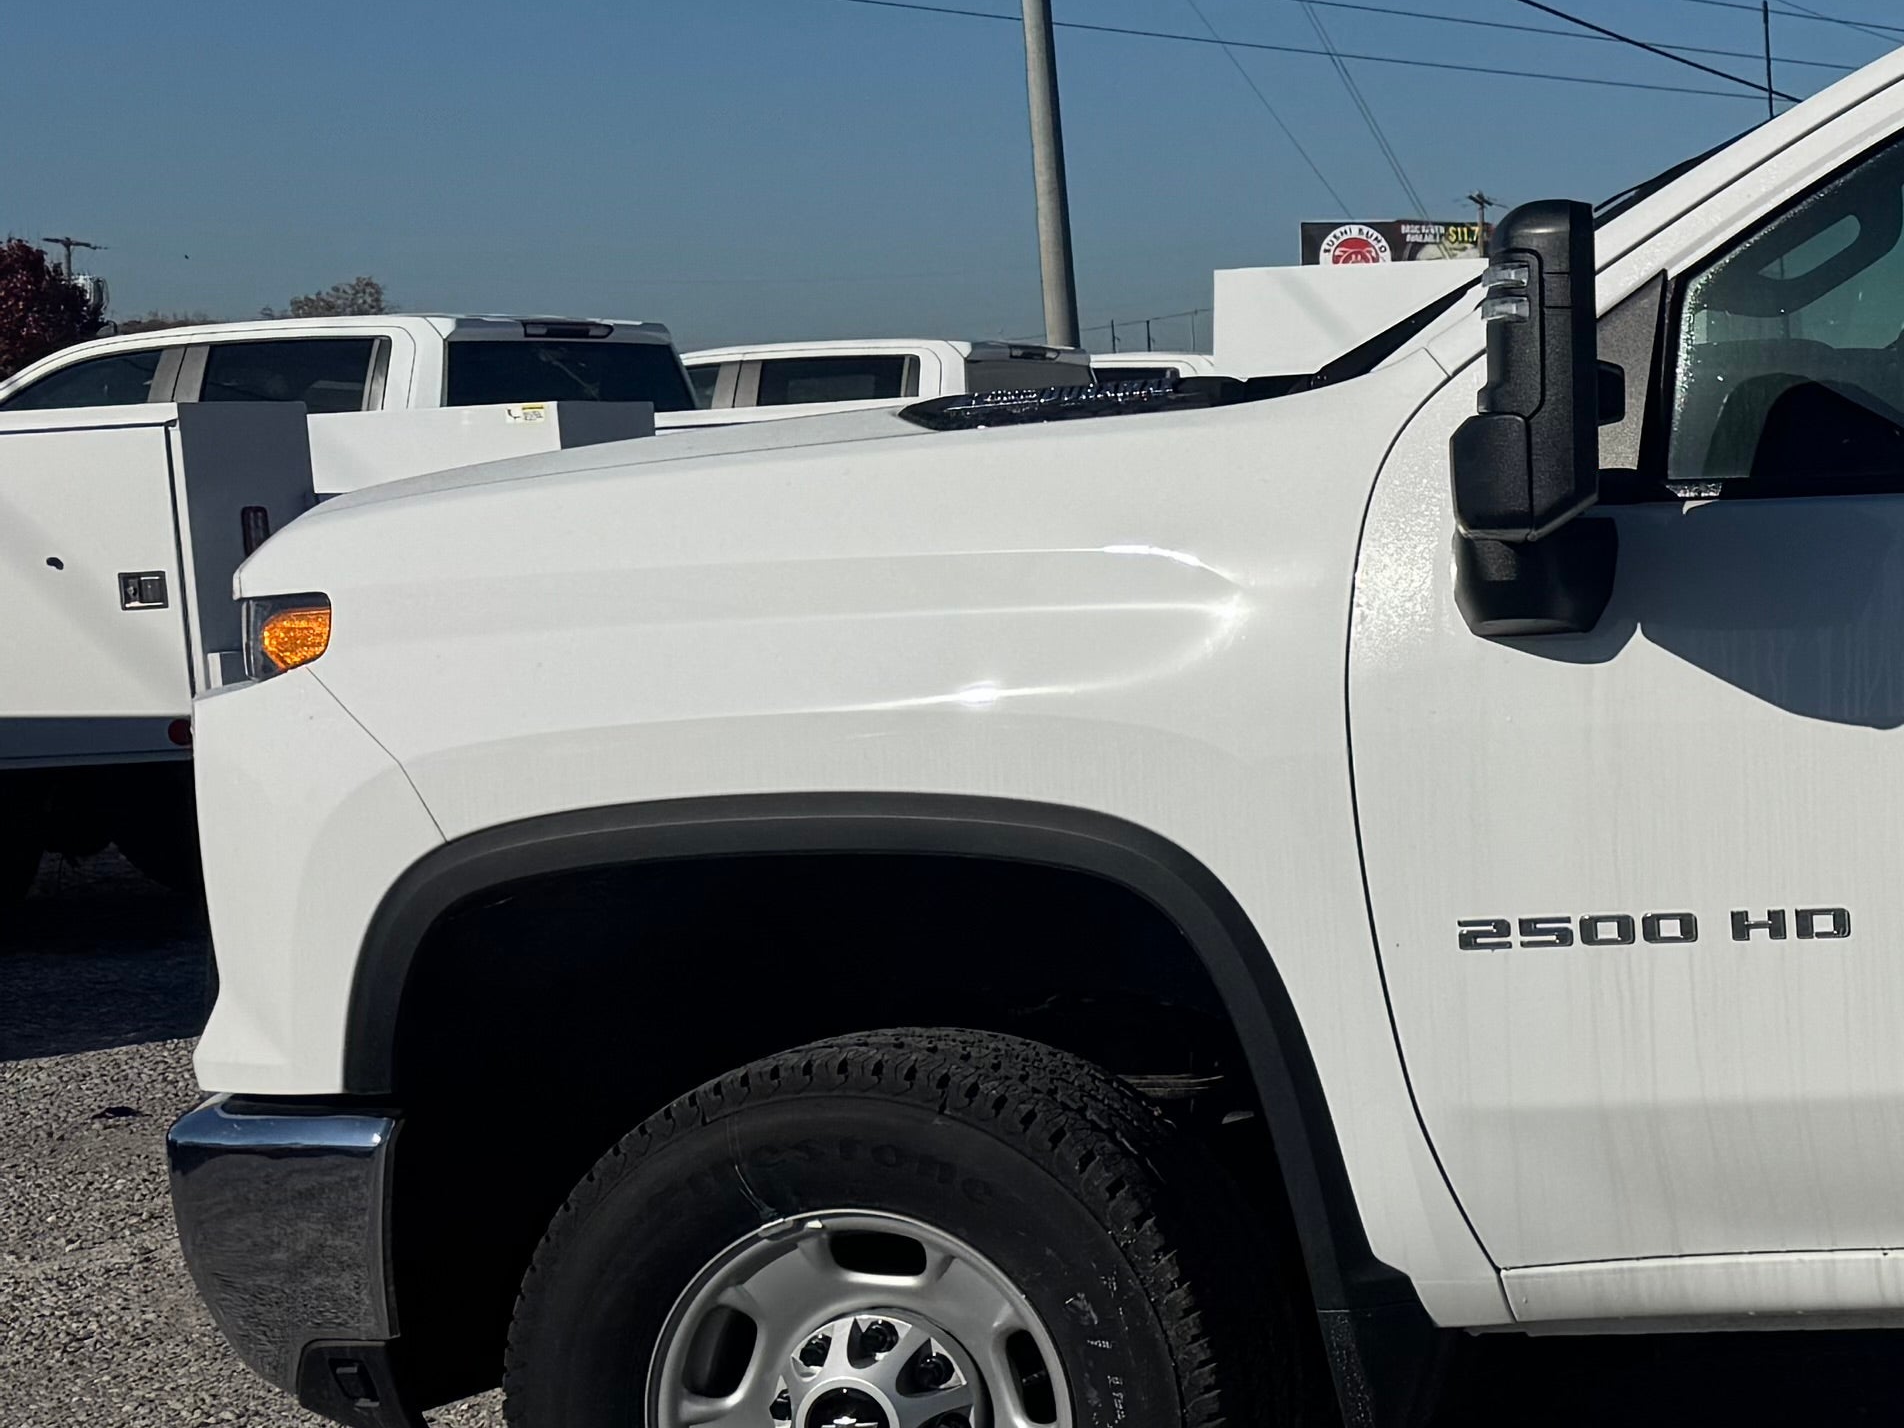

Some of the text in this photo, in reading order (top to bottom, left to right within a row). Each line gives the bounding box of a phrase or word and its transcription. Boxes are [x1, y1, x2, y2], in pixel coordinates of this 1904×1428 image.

[1448, 225, 1480, 244] $11.7
[1457, 907, 1851, 951] 2500 HD
